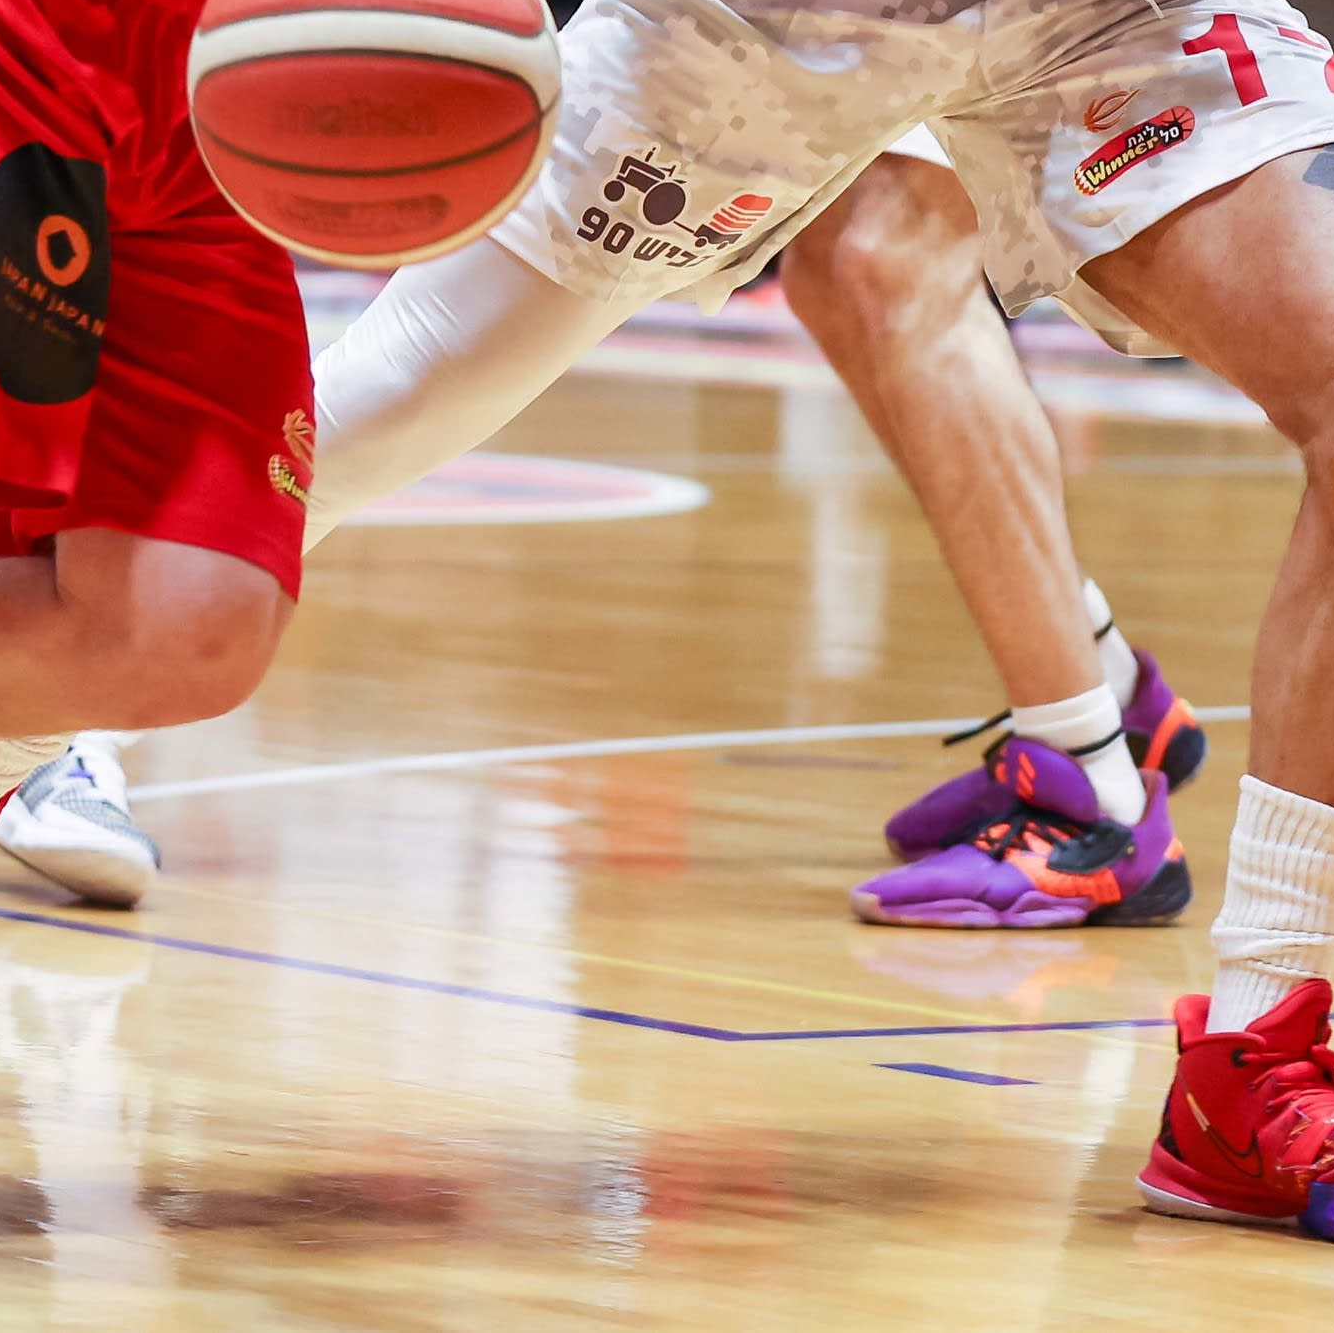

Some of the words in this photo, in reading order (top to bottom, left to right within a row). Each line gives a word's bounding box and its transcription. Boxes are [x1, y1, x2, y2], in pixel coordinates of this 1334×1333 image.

[1085, 136, 1159, 186] Winner
[1159, 126, 1180, 143] סל
[1127, 125, 1155, 148] ליגת
[577, 207, 634, 254] 90
